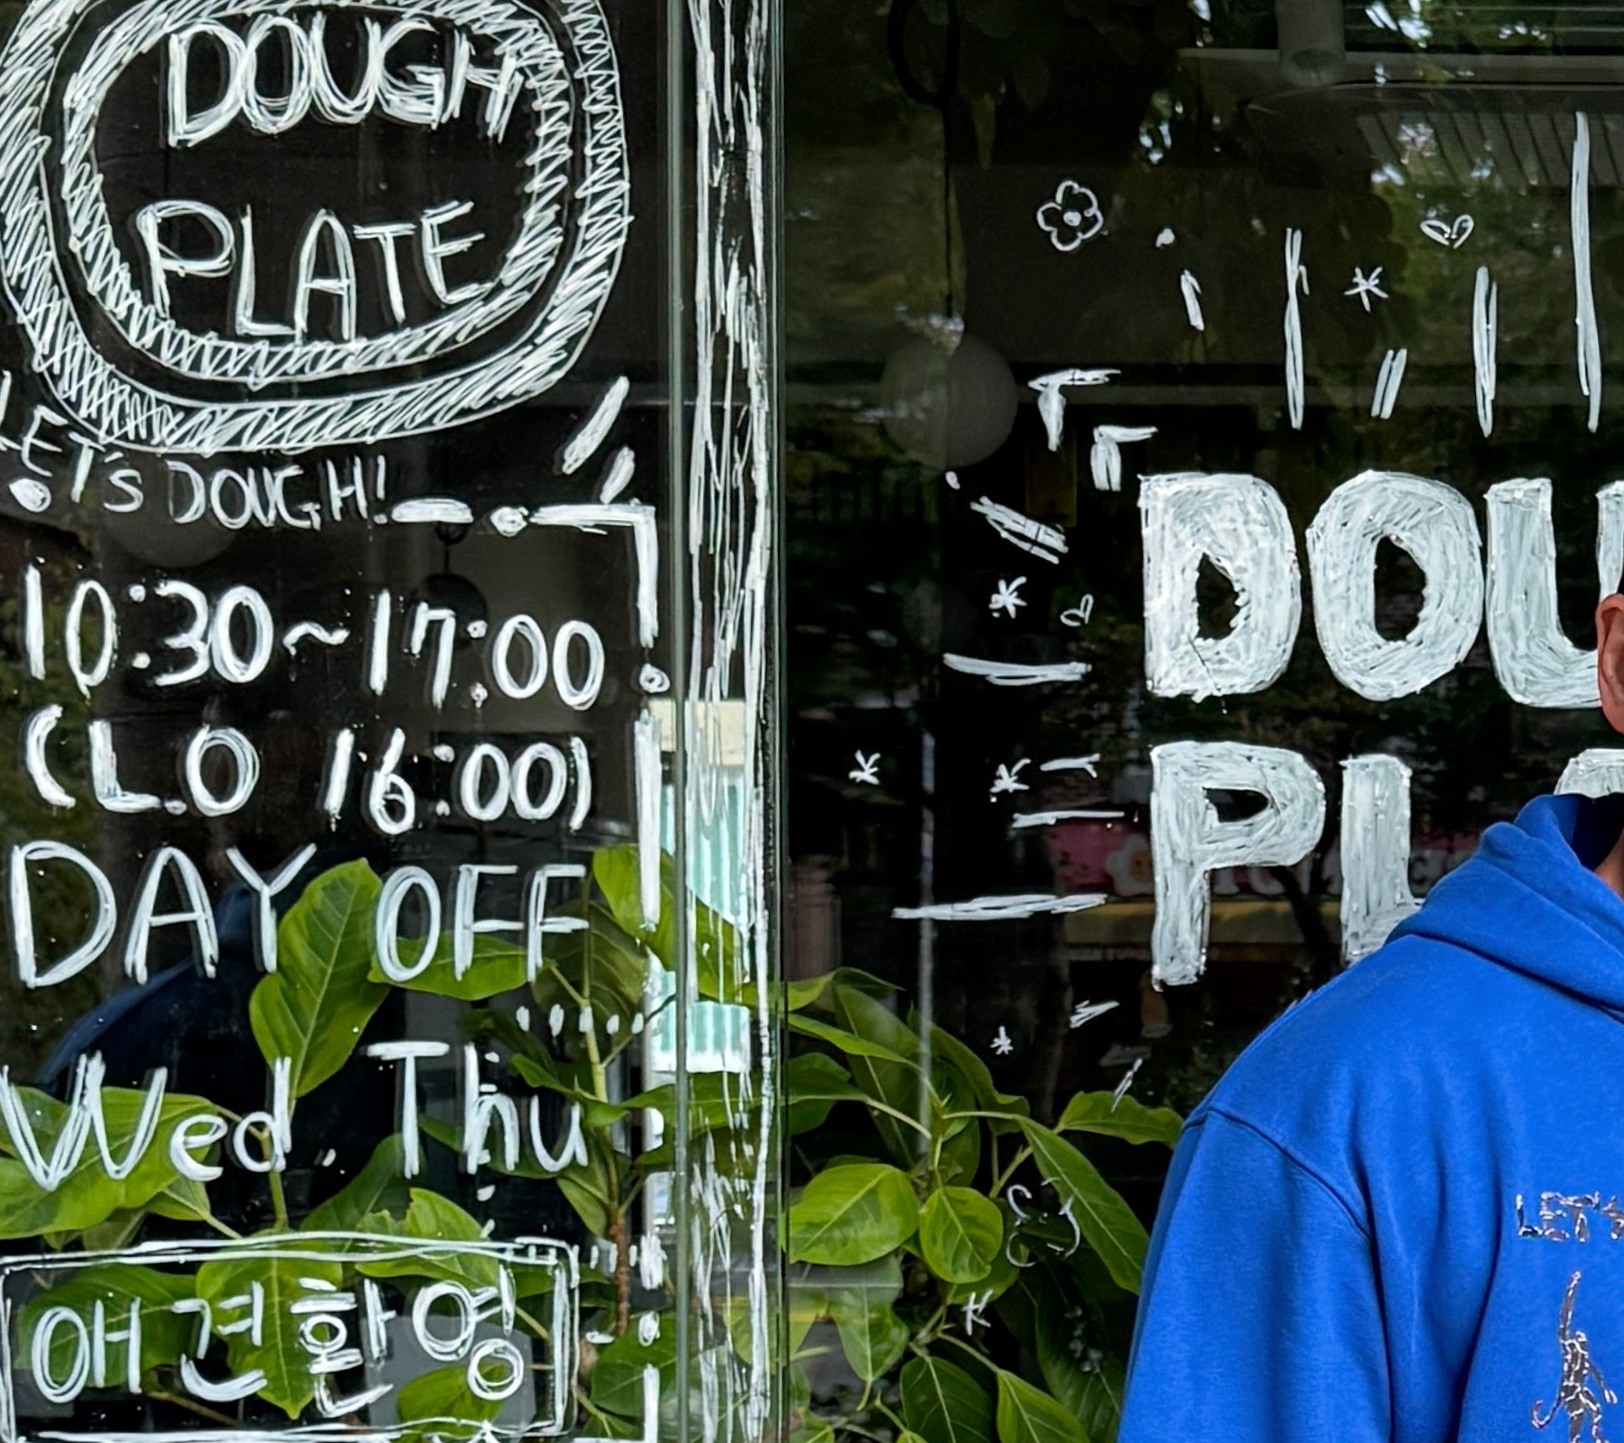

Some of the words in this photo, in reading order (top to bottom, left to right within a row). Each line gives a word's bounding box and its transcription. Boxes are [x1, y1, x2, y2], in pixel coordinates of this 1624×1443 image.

[169, 12, 522, 147] DOUGH
[136, 201, 491, 340] PLATE
[167, 456, 388, 530] DOUGH!
[324, 728, 591, 834] 16:00)
[13, 840, 316, 989] DAY
[375, 864, 589, 983] OFF
[362, 1040, 589, 1178] Thu
